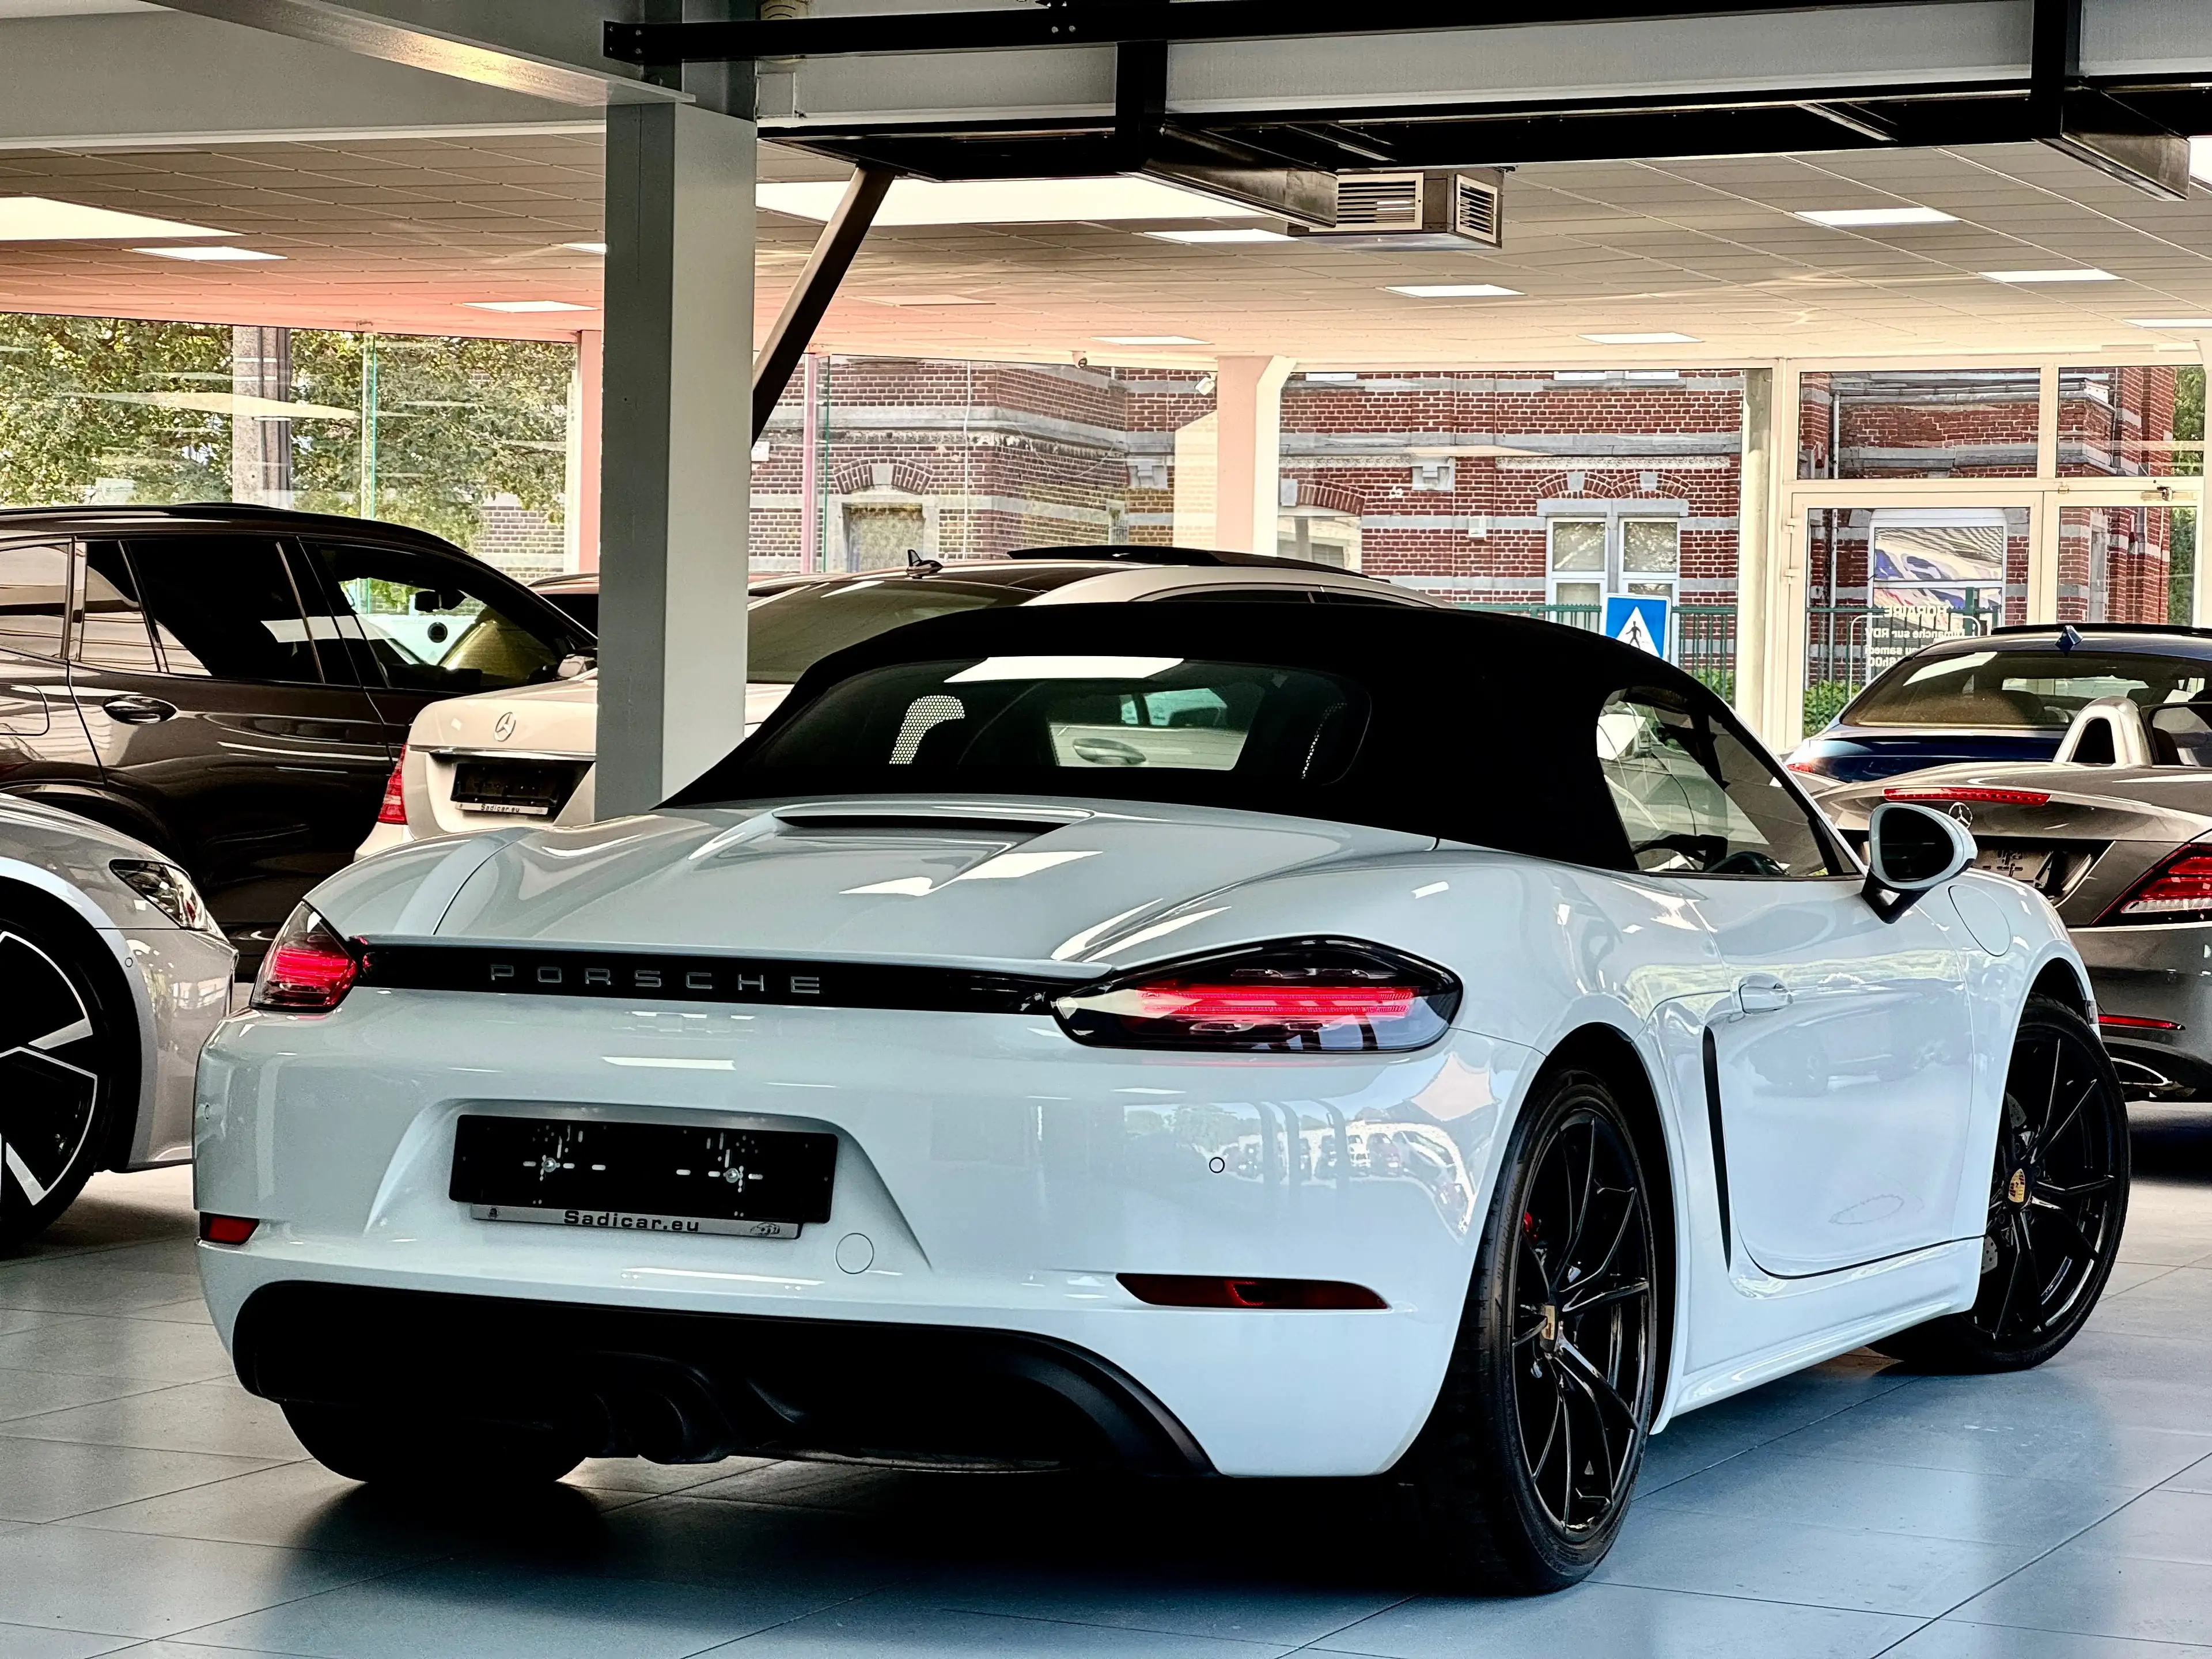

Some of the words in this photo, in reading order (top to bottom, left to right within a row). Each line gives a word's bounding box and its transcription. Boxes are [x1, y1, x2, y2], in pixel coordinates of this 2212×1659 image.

[480, 804, 520, 813] Sadicareu
[490, 964, 821, 994] PORSCHE
[563, 1210, 700, 1232] Sadicar.eu
